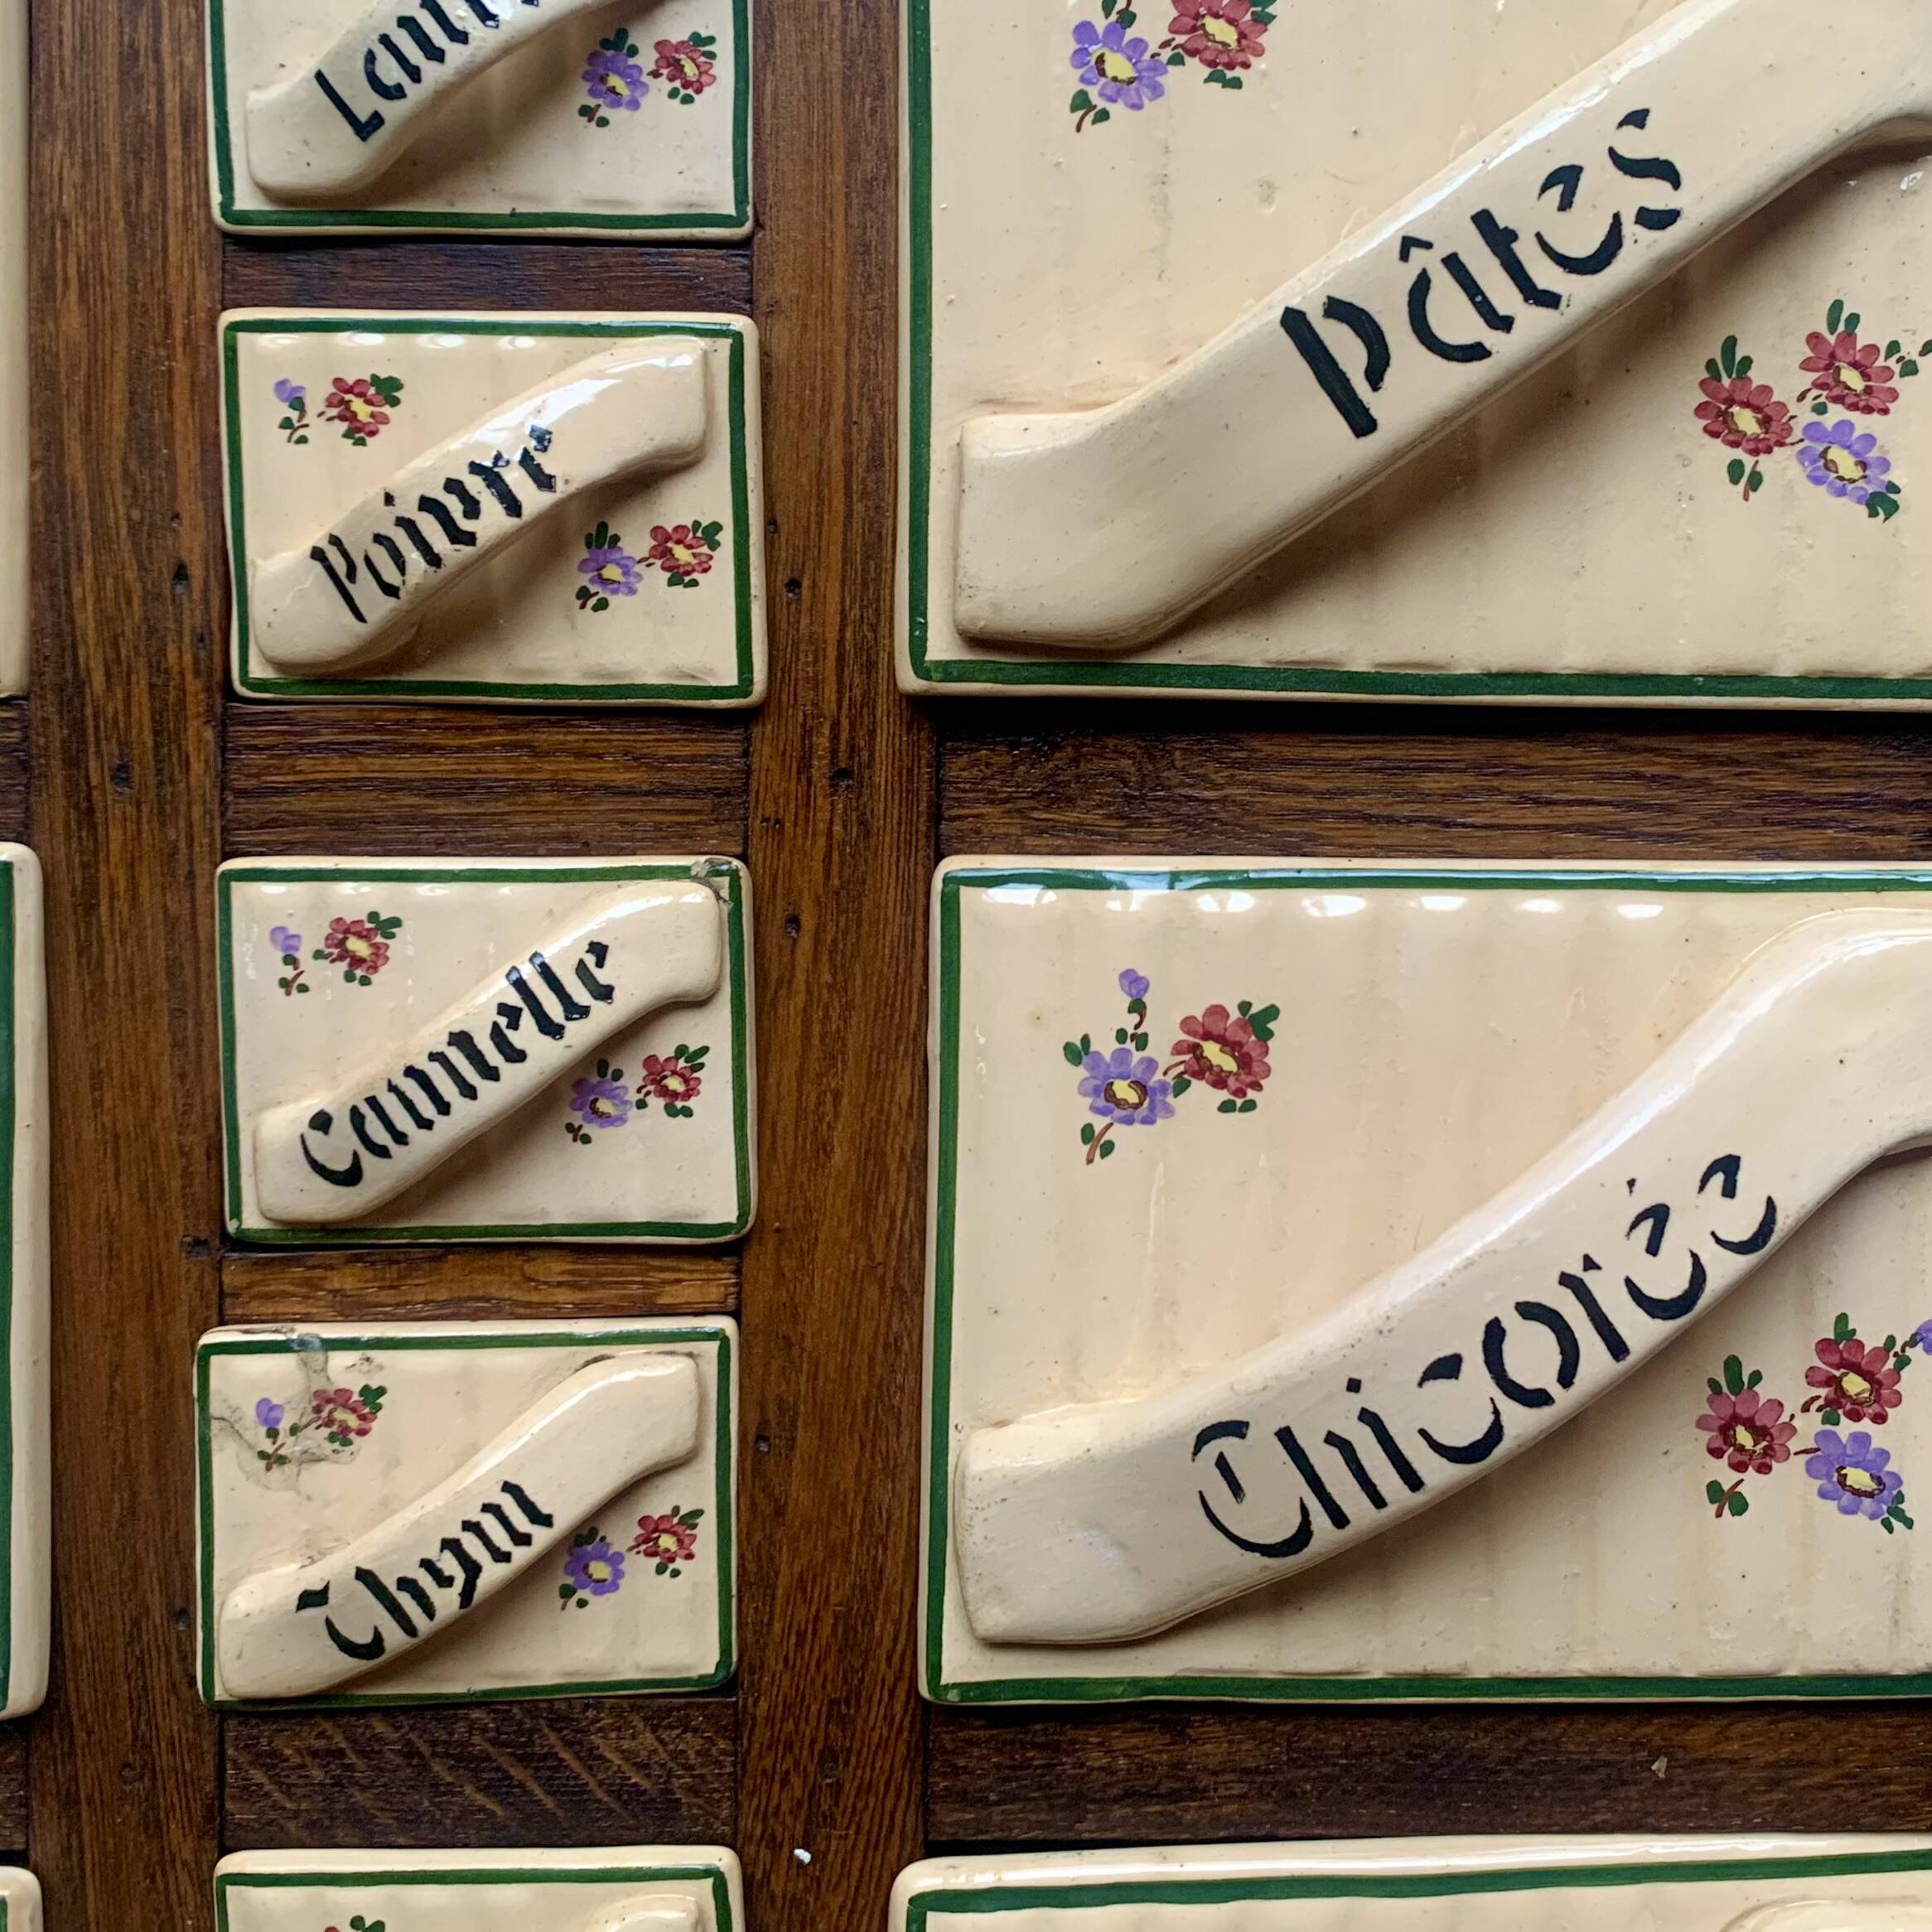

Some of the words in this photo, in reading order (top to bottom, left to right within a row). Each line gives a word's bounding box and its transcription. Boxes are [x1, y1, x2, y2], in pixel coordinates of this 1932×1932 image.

[1279, 107, 1683, 439] Pâtes
[309, 423, 557, 624] Poivre
[300, 939, 616, 1187] Cannelle
[1191, 1153, 1779, 1559] Chicorée
[295, 1480, 554, 1661] Thym
